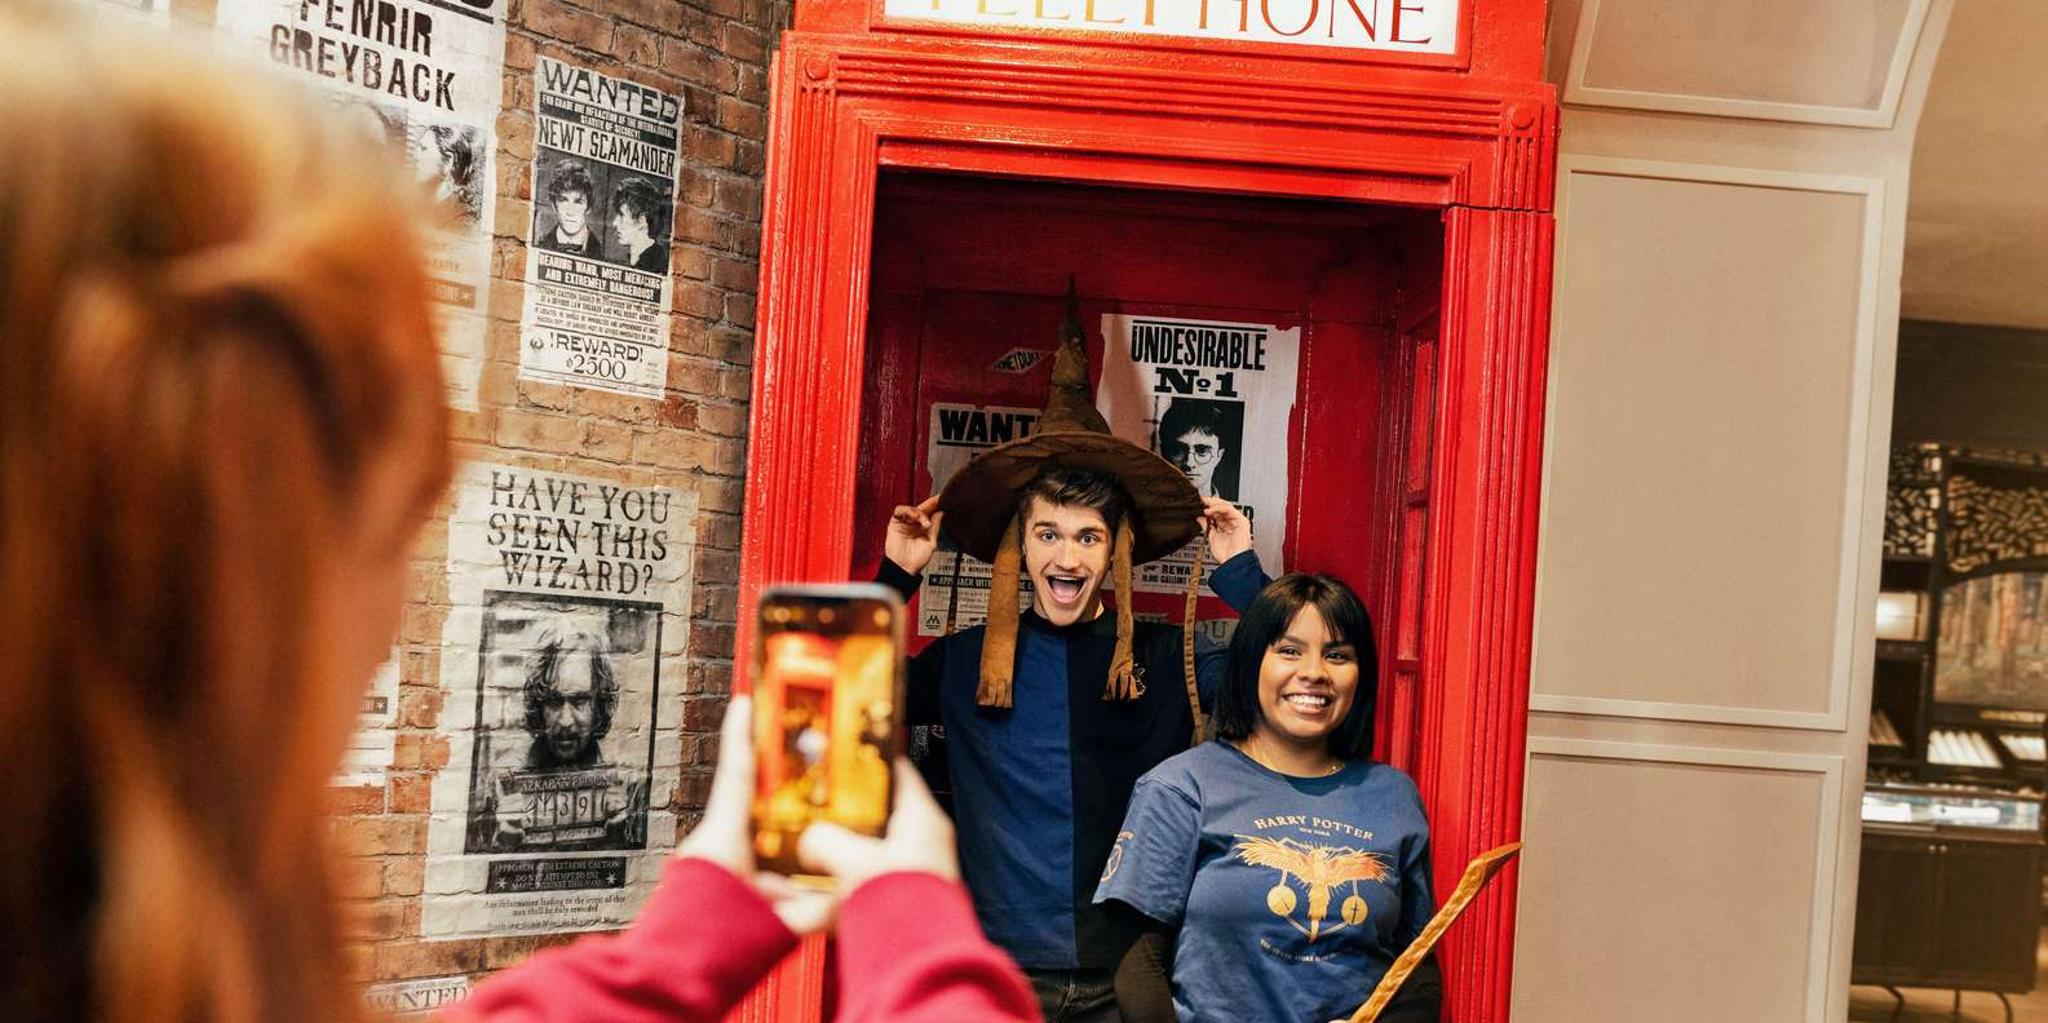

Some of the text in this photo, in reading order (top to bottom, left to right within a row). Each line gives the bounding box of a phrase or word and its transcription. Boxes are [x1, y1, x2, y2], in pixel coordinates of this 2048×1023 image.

[270, 23, 455, 111] GREYBACK
[543, 60, 678, 124] WANTED
[539, 117, 676, 177] NEWT SCAMANDER
[545, 267, 562, 281] AND
[565, 270, 607, 291] EXTREMELY
[609, 279, 654, 301] DANGEROUS!
[602, 266, 623, 281] MOST
[1131, 325, 1268, 371] UNDESIRABLE
[939, 410, 1041, 443] WANT
[490, 471, 671, 524] HAVE YOU
[487, 513, 668, 561] SEEN THIS
[500, 550, 654, 595] WIZARD?
[1254, 815, 1374, 841] HARRY POTTER
